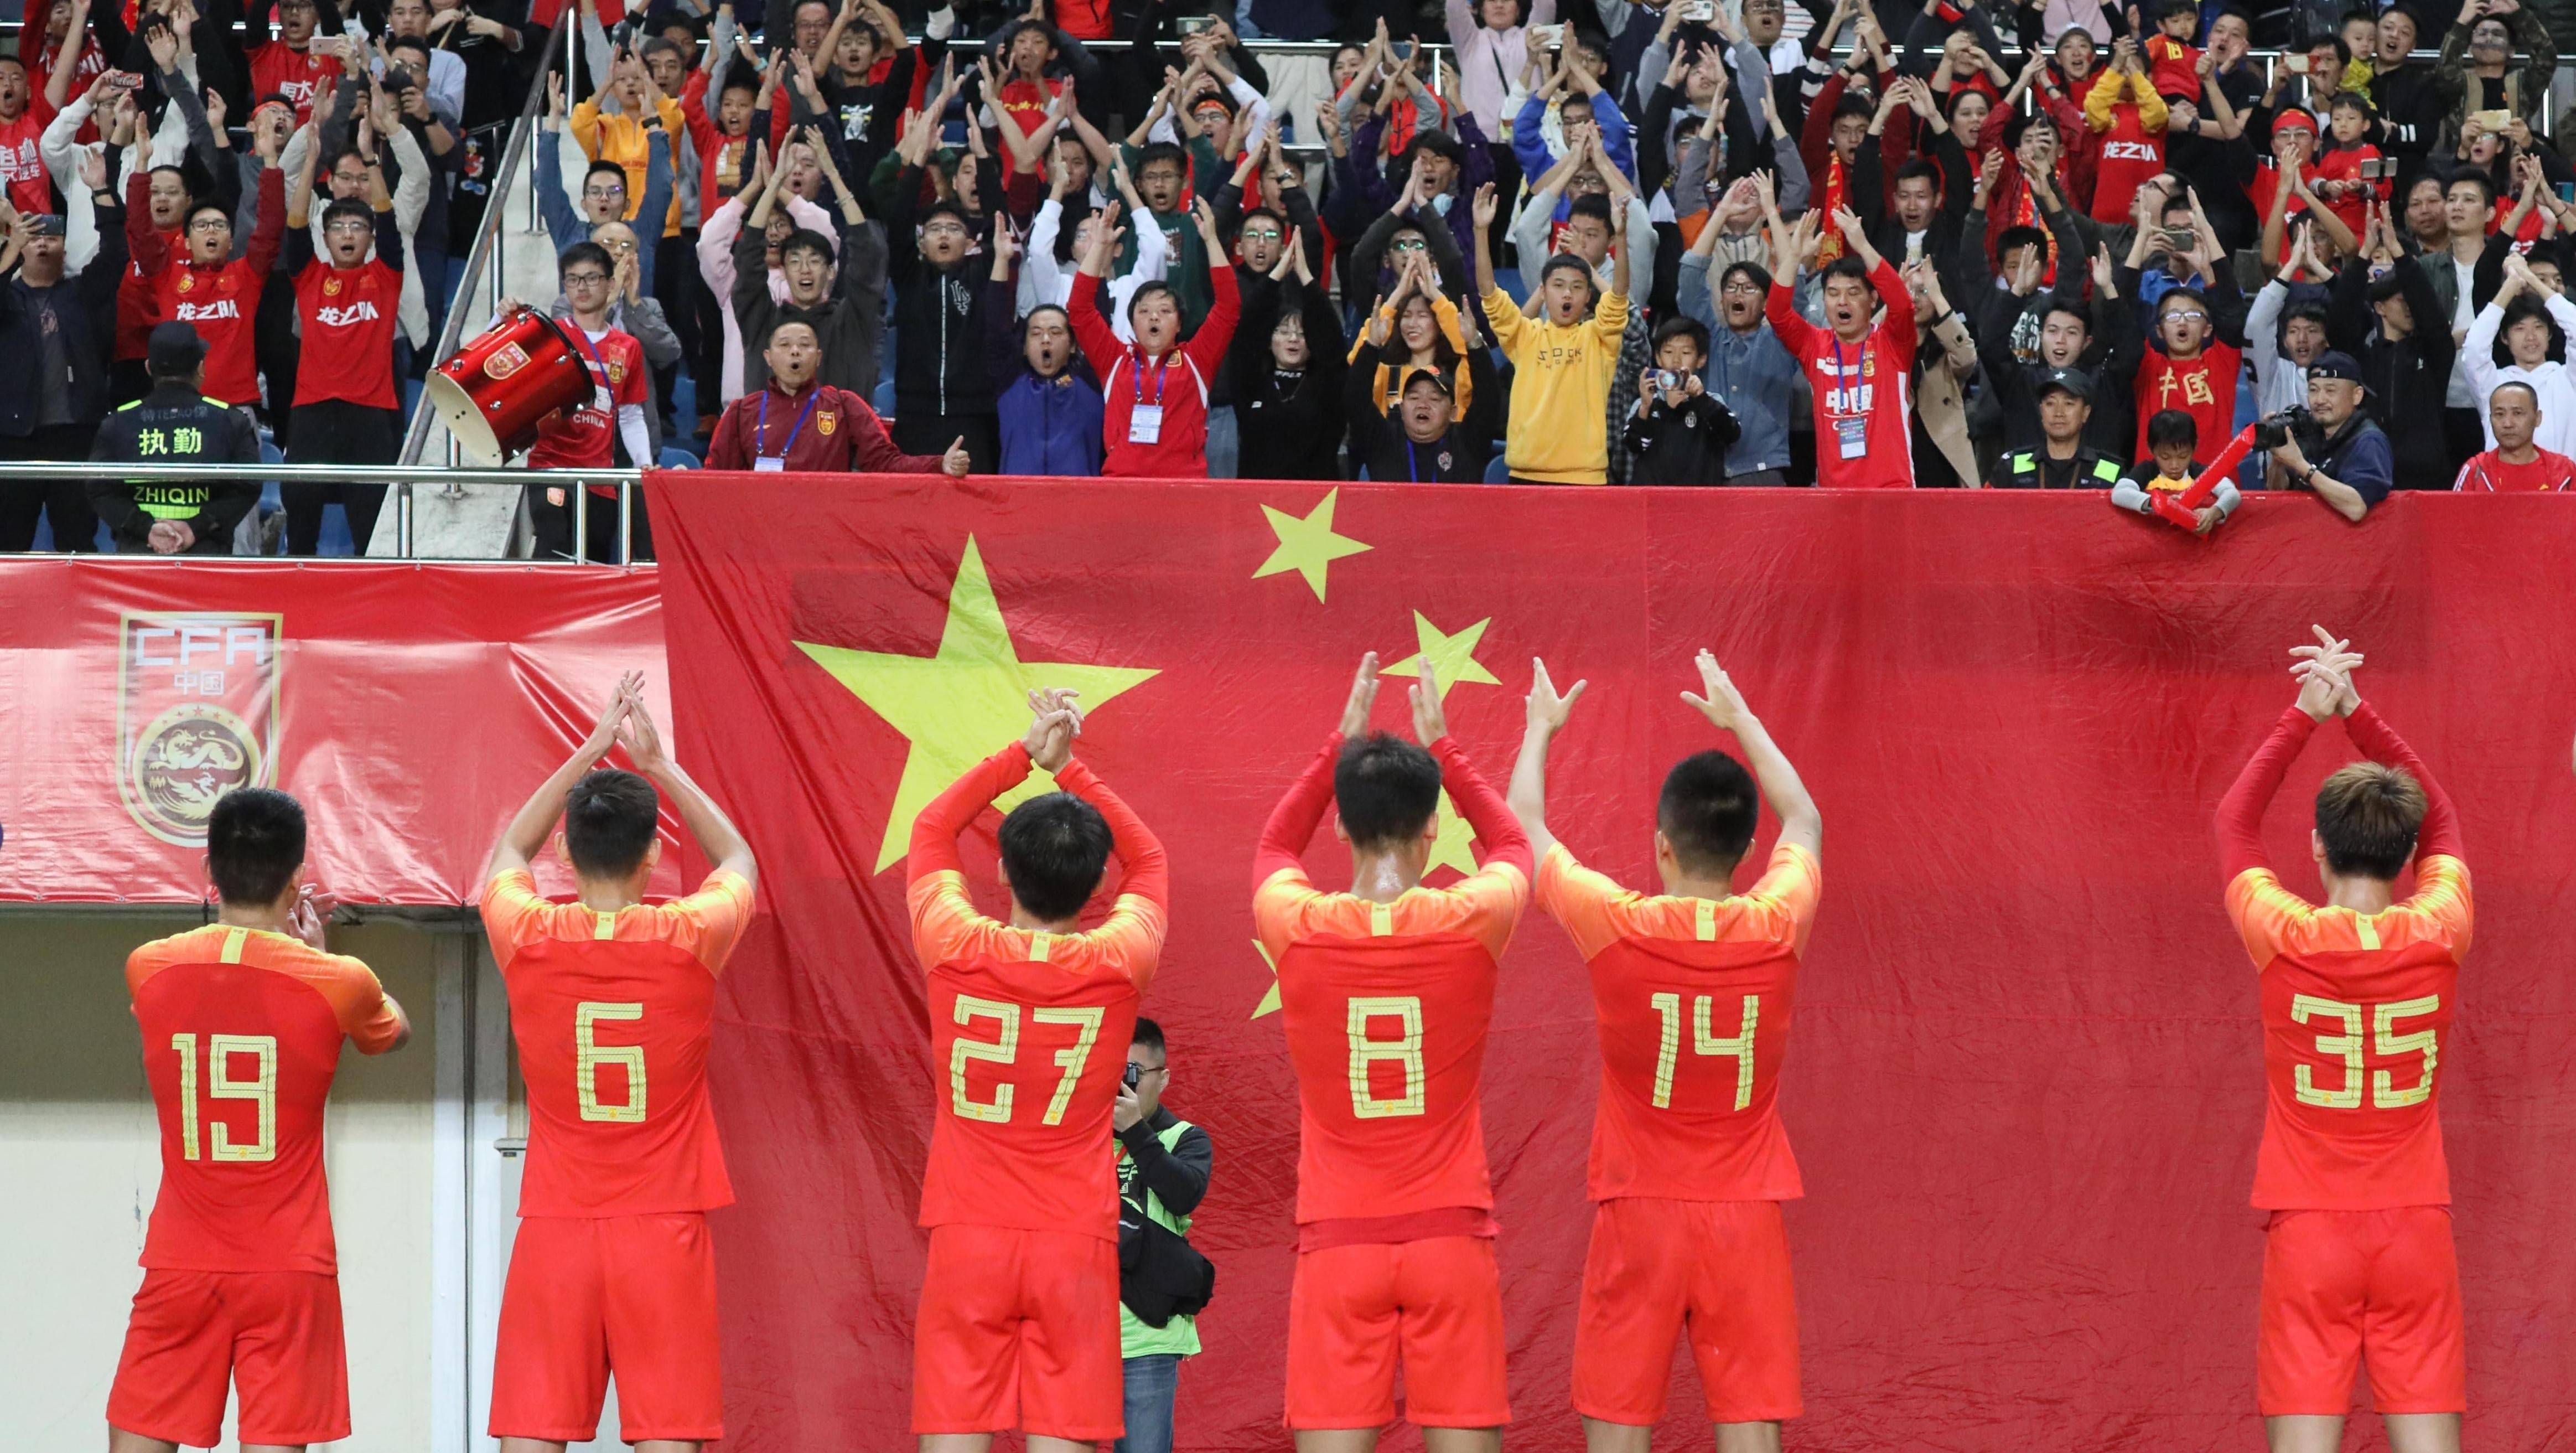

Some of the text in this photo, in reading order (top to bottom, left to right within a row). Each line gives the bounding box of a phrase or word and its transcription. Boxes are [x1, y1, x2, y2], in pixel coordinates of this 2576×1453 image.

[573, 413, 606, 429] CHINA
[2158, 366, 2214, 410] 中国
[138, 427, 202, 456] 执勤
[133, 486, 209, 505] ZHIQIN
[136, 627, 266, 666] CFA
[174, 670, 225, 696] 中国
[576, 1001, 647, 1123] 6
[950, 993, 1106, 1126] 27
[1346, 996, 1426, 1119] 8
[1651, 992, 1759, 1112] 14
[2290, 993, 2439, 1109] 35
[172, 1033, 277, 1162] 19
